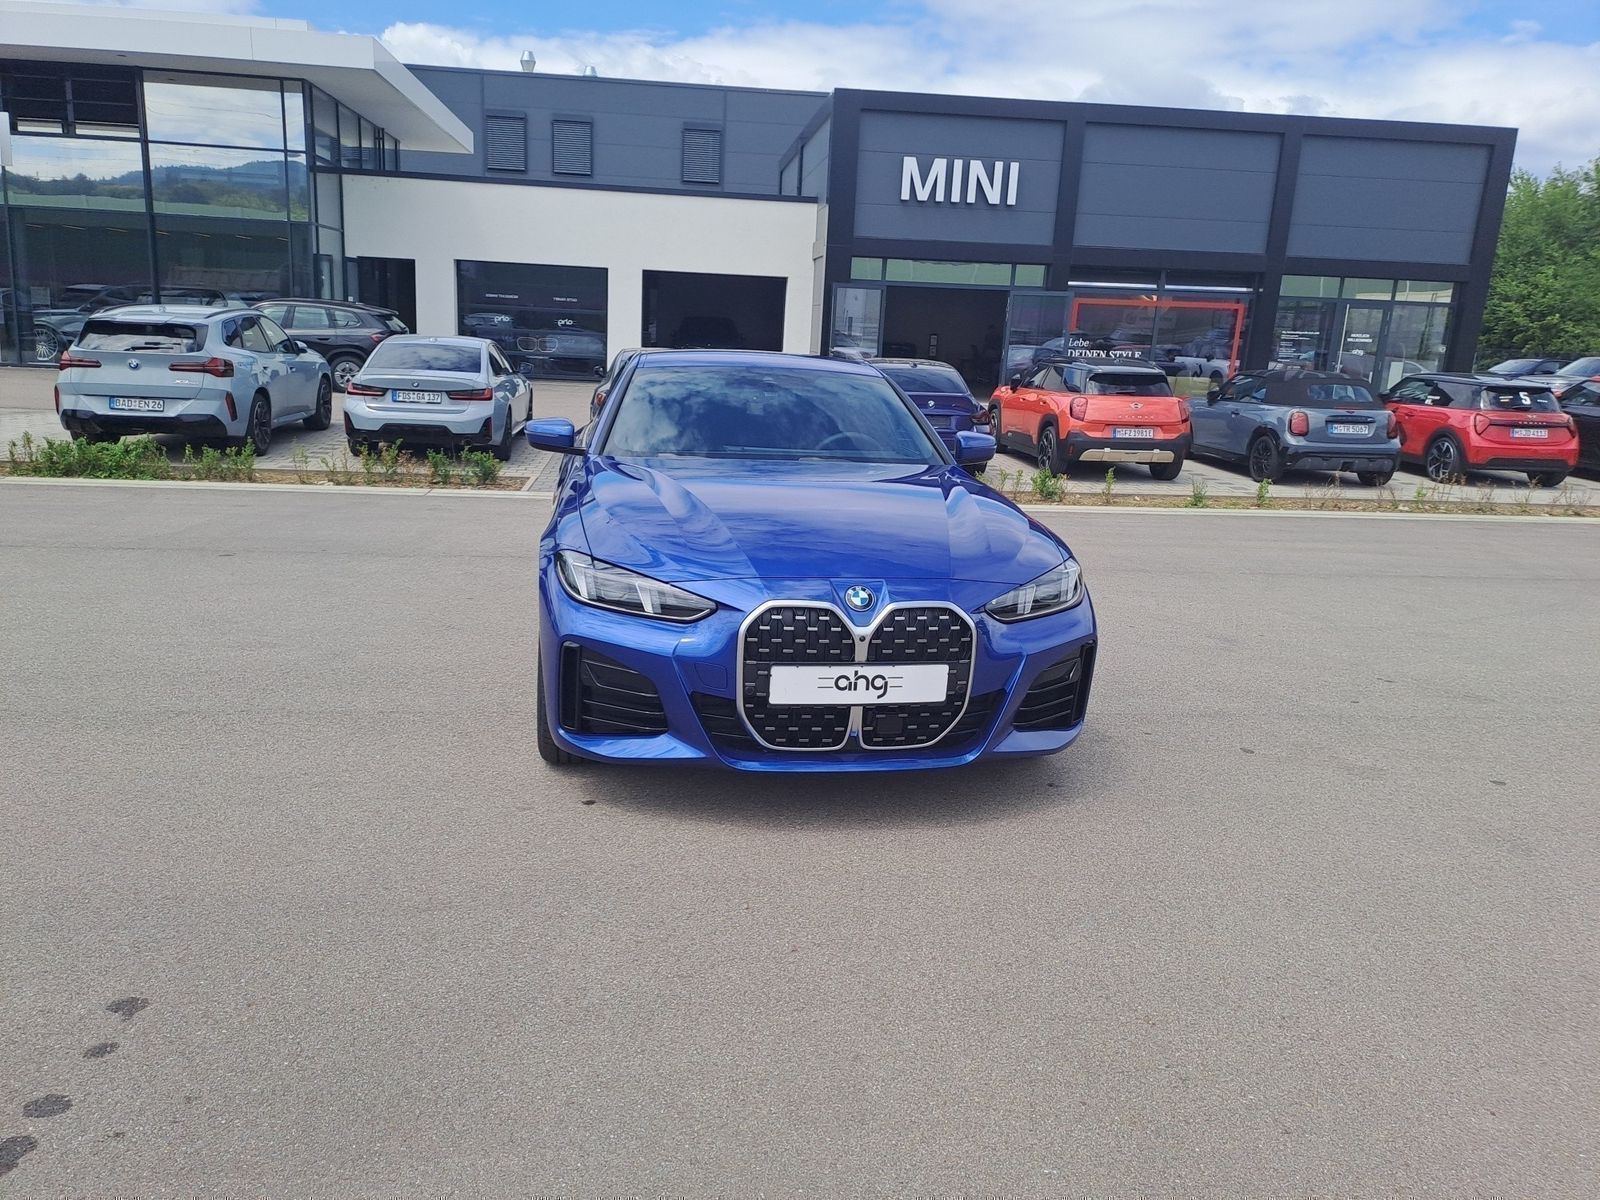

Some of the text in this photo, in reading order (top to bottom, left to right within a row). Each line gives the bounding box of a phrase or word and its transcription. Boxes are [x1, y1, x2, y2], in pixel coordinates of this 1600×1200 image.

[900, 156, 1020, 206] MINI
[494, 315, 510, 323] prio
[557, 318, 573, 327] prio
[1068, 338, 1090, 347] Lebe
[1518, 392, 1531, 404] 5
[151, 400, 162, 409] 26
[834, 669, 889, 700] ahg
